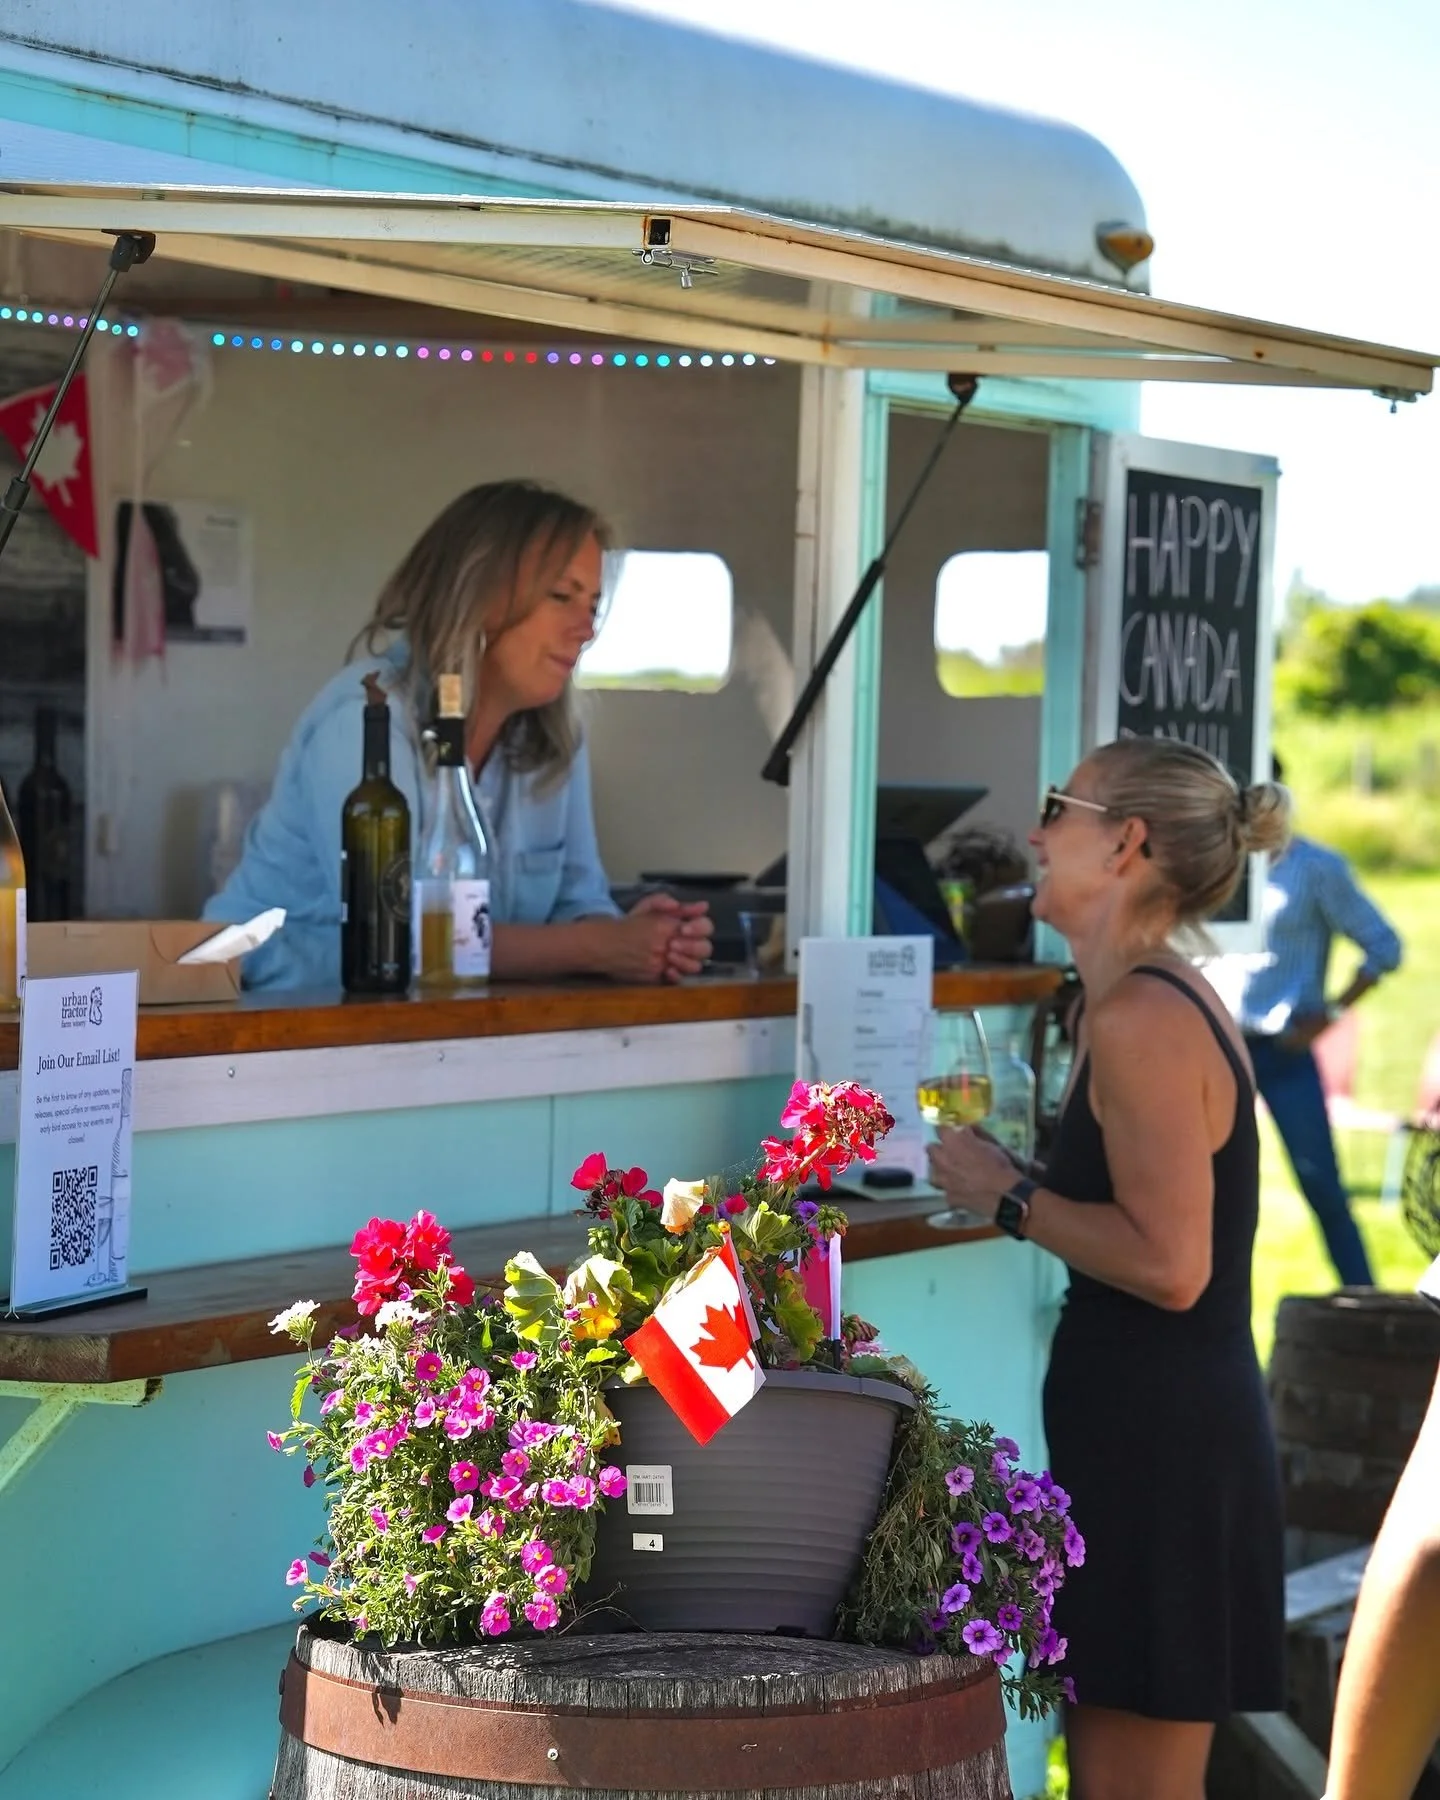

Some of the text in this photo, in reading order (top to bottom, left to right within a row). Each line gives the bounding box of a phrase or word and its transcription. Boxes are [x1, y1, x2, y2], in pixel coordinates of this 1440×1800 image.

[1127, 493, 1259, 608] HAPPY
[1120, 611, 1243, 715] CANADA
[62, 992, 88, 1006] urban
[61, 1007, 87, 1019] tractor
[36, 1047, 120, 1075] Join Our Email List!
[66, 1090, 77, 1100] know
[55, 1107, 69, 1118] special
[40, 1122, 50, 1135] early
[51, 1121, 61, 1132] bird
[62, 1122, 76, 1131] access
[649, 1540, 655, 1548] 4
